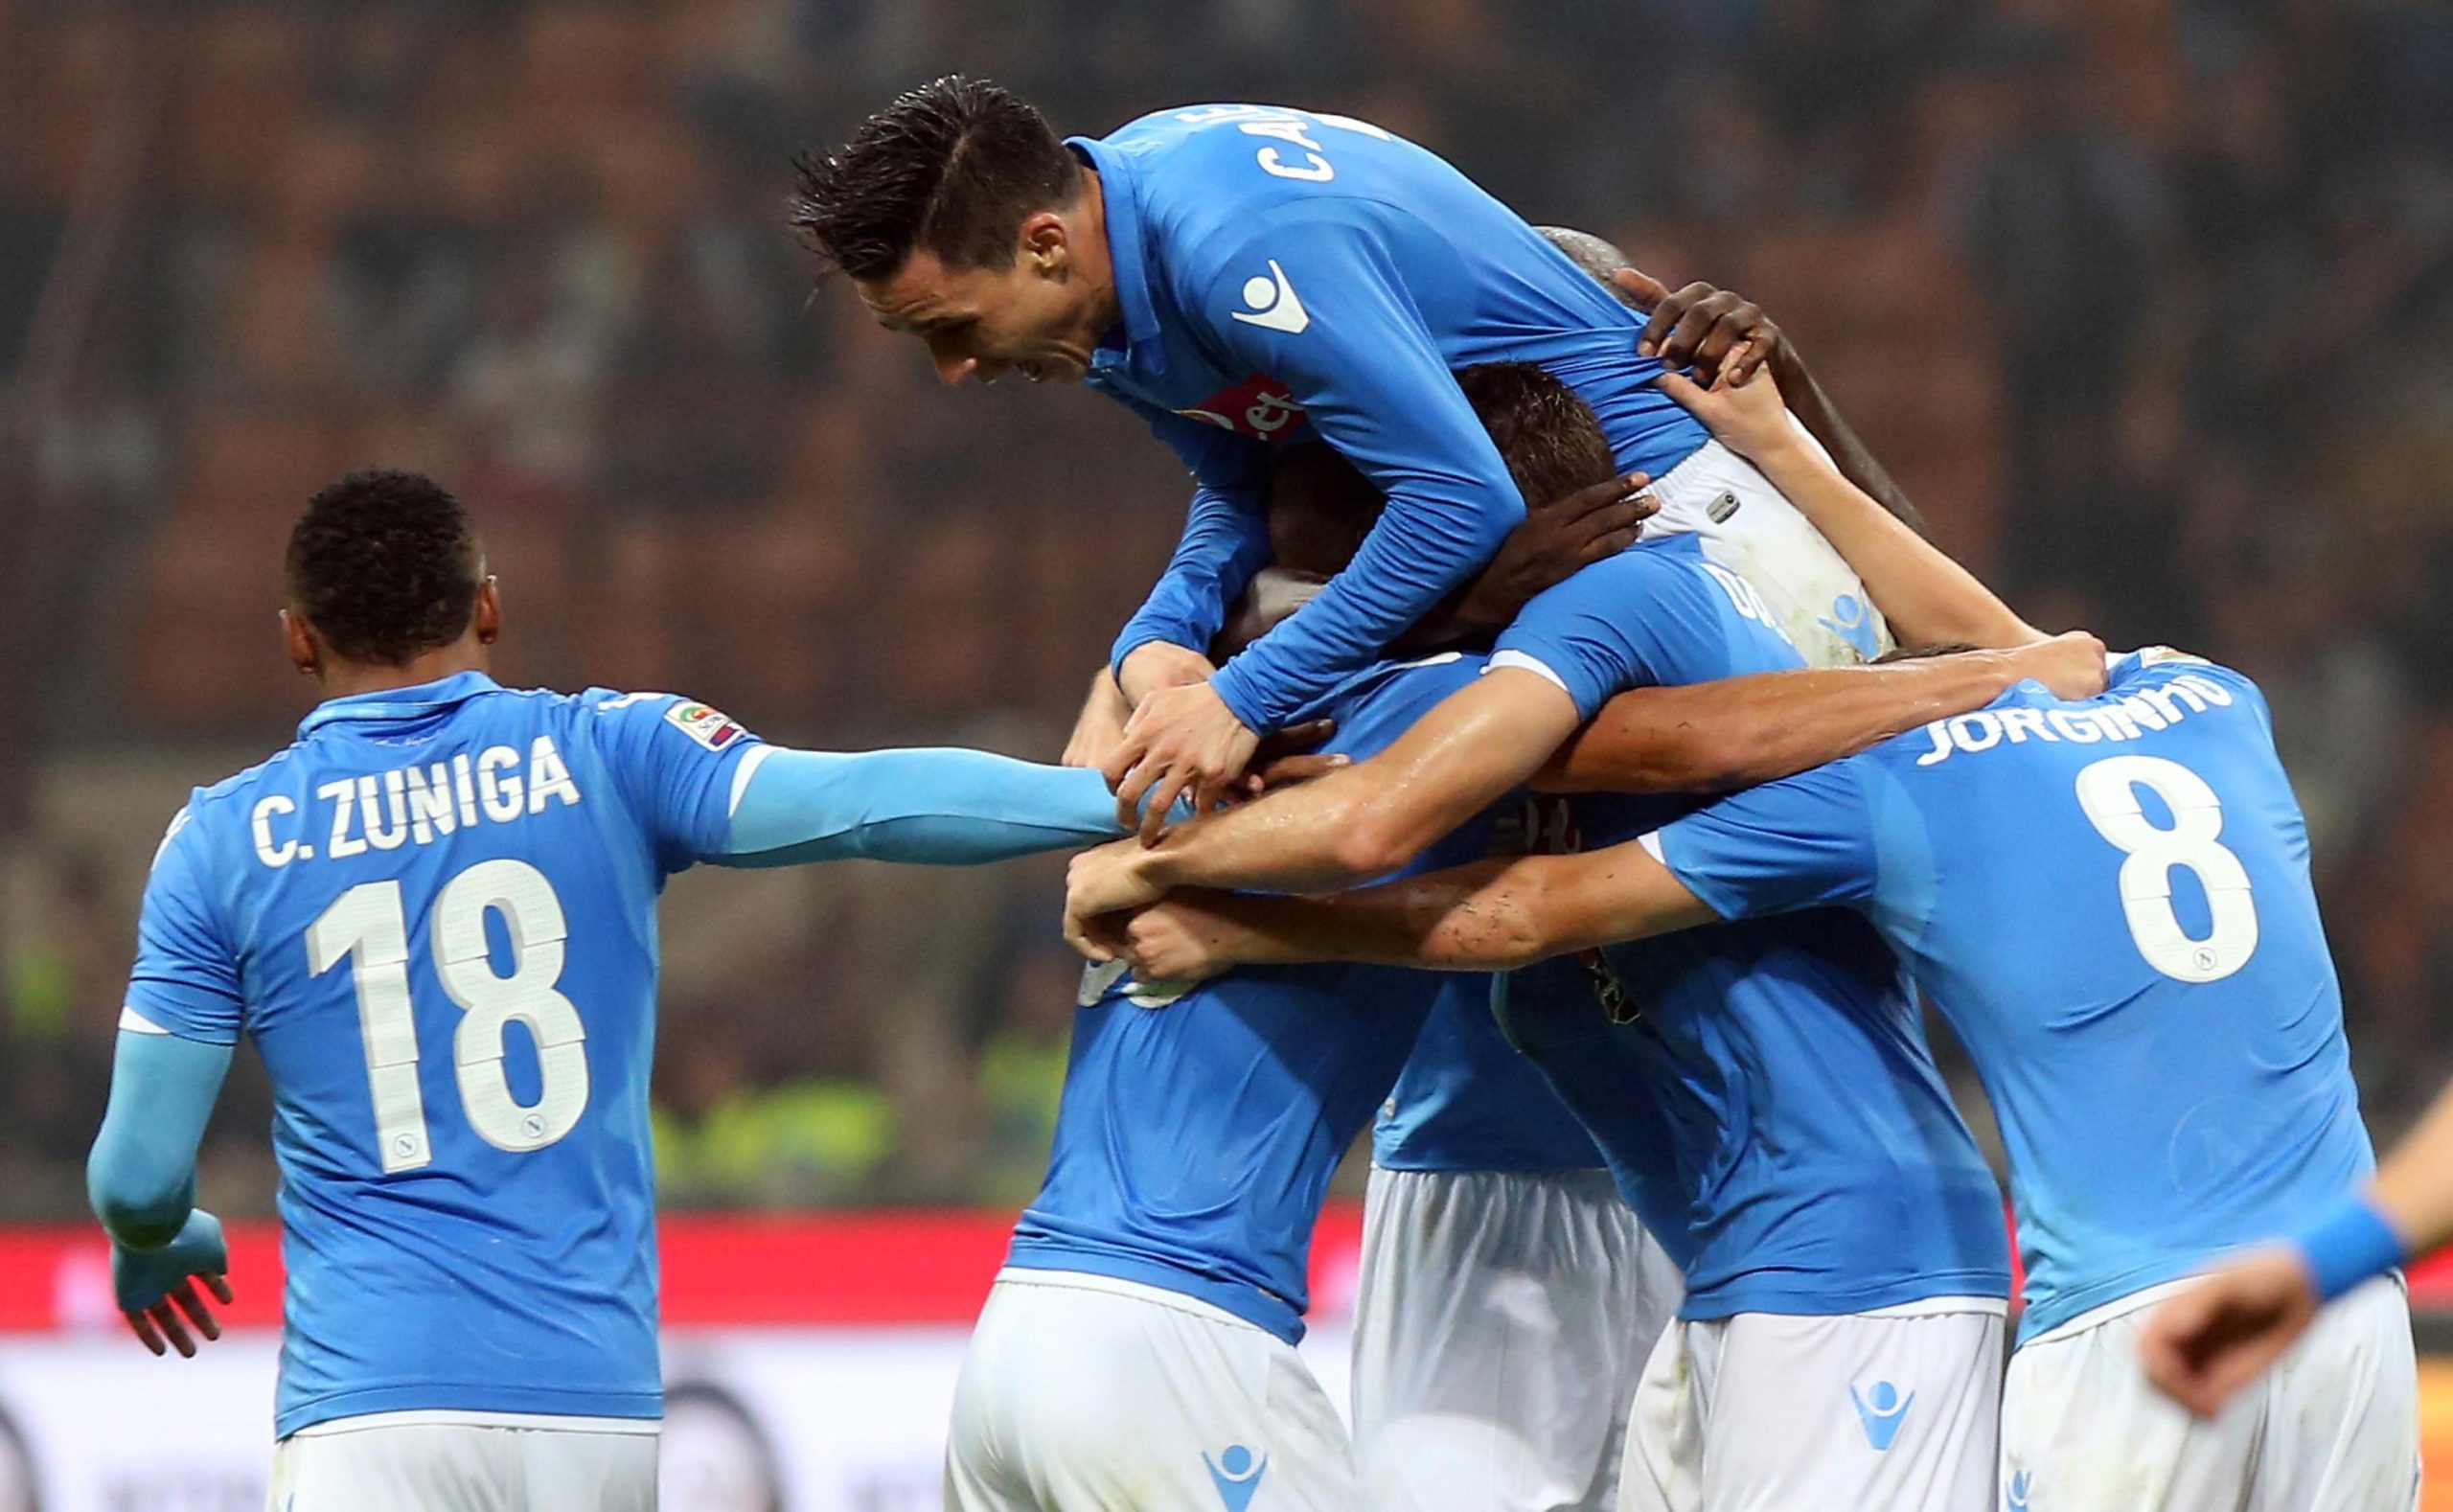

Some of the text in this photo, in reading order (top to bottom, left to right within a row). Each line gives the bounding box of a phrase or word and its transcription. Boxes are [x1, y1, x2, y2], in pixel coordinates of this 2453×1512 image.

[252, 734, 581, 868] C. ZUNIGA
[2075, 754, 2259, 984] 8
[305, 859, 589, 1174] 18
